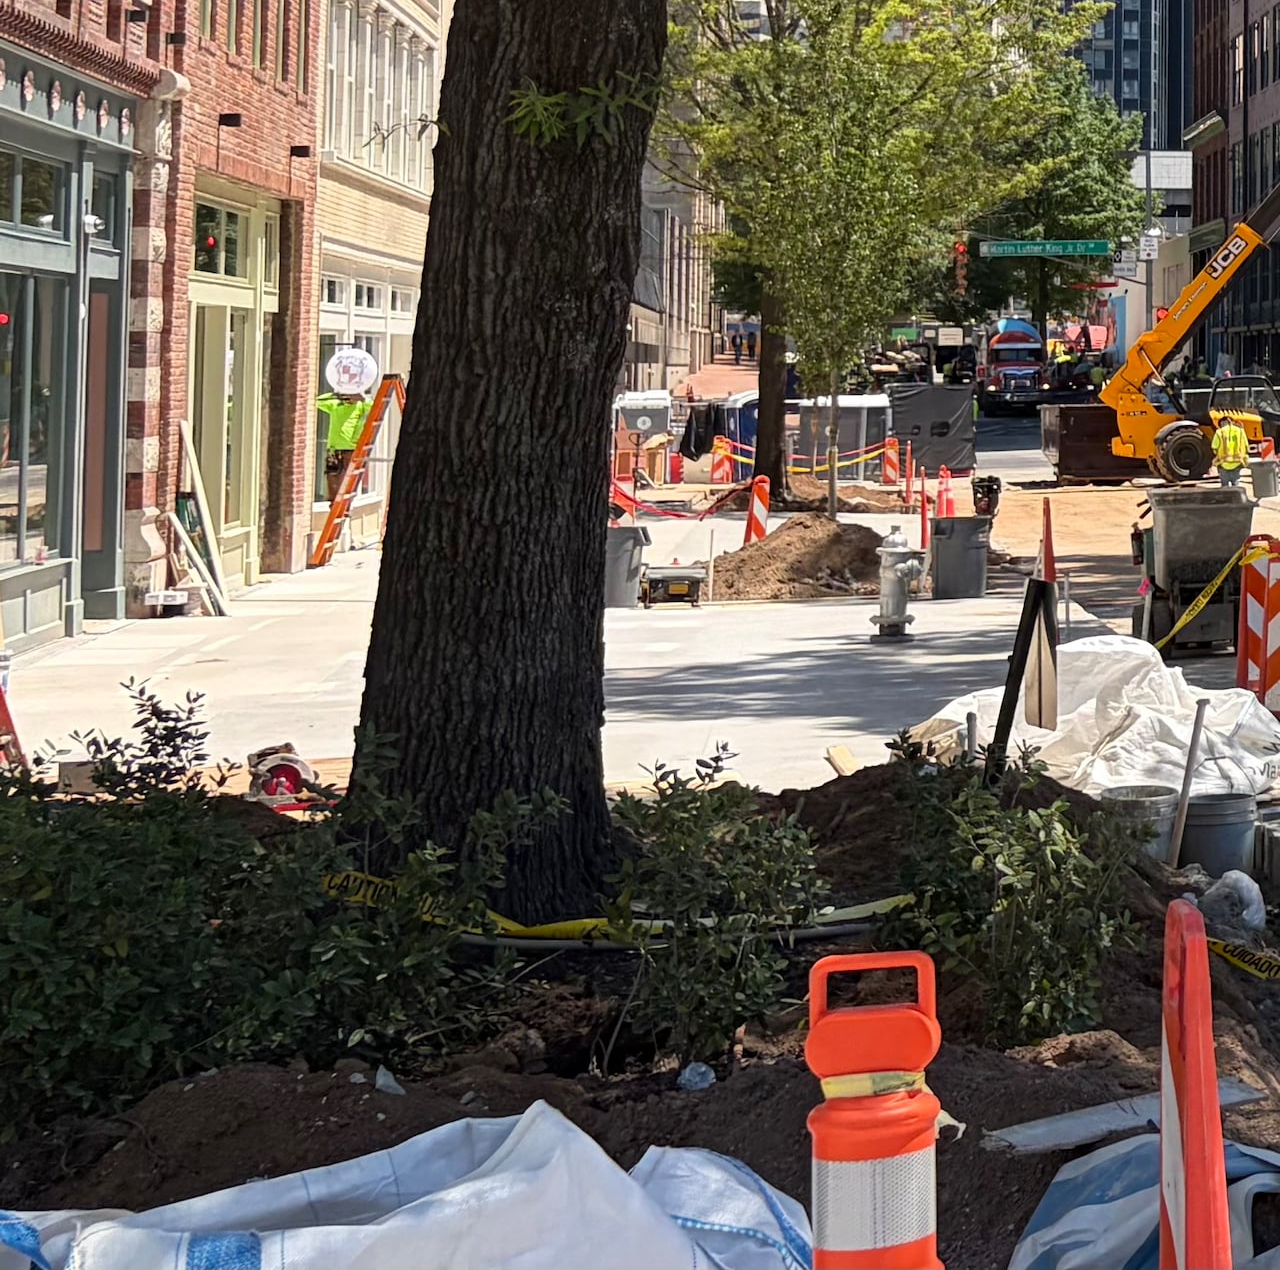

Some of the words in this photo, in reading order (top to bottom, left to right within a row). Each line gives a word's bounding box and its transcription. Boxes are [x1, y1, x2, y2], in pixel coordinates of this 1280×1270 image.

[990, 245, 1015, 254] Martin
[1017, 244, 1043, 254] Luther
[1045, 243, 1063, 255] King
[1077, 243, 1086, 252] Dr
[1211, 237, 1247, 279] JCB
